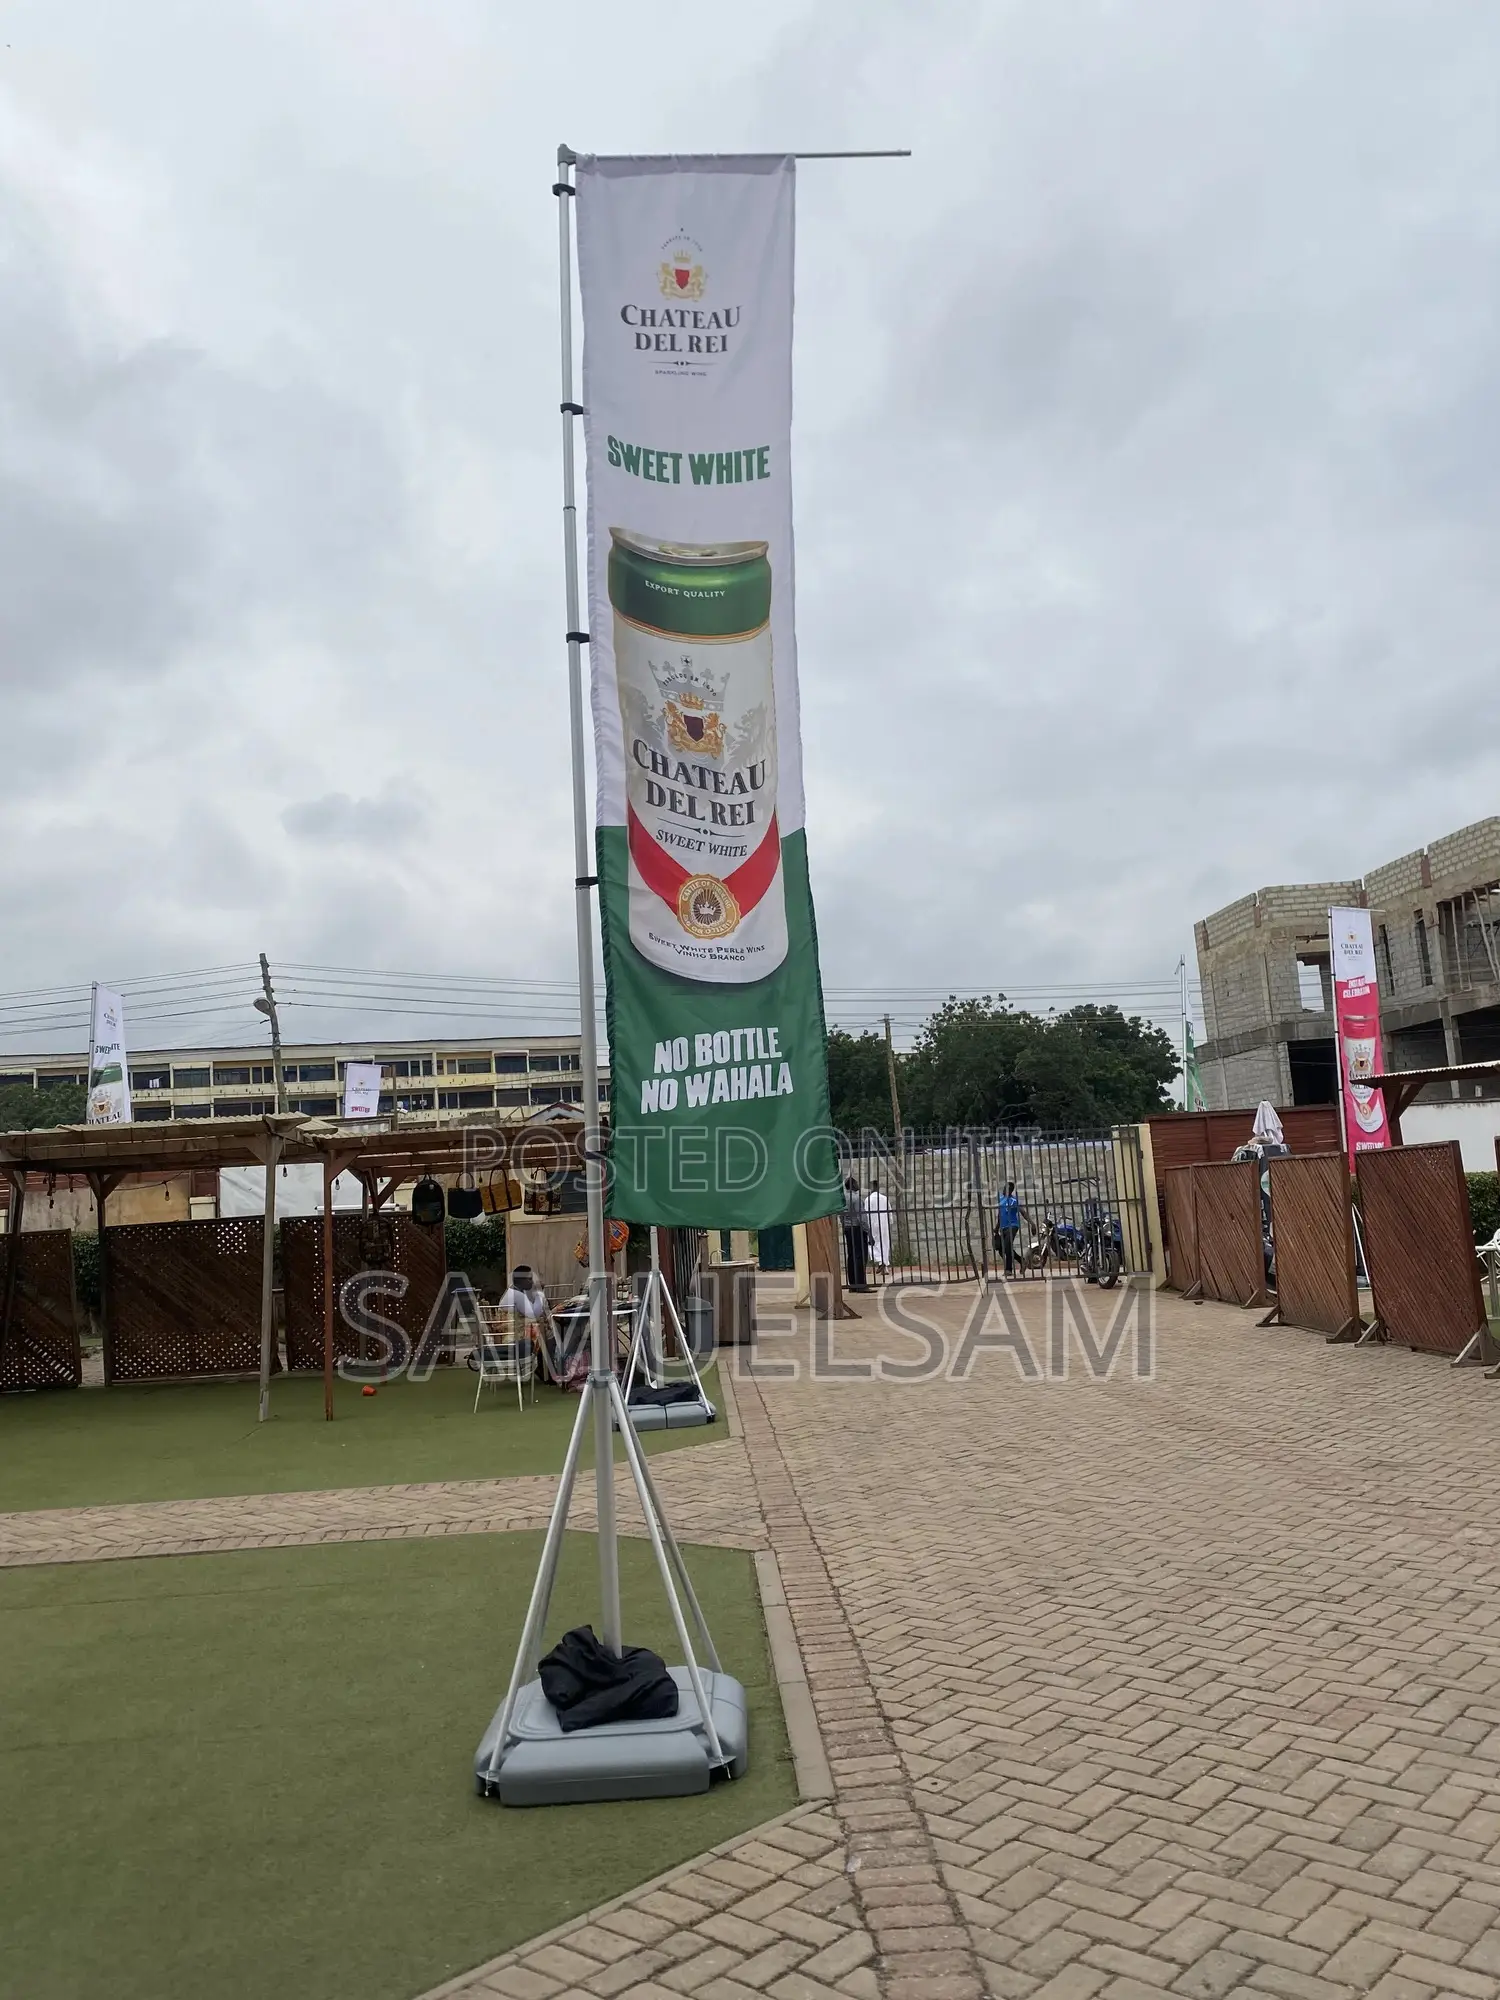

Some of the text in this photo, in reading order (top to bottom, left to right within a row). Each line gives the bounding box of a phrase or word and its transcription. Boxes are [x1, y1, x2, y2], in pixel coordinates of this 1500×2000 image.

[620, 304, 741, 330] CHATEAU
[635, 332, 728, 353] DEL REI
[607, 434, 771, 485] SWEET WHITE
[644, 580, 726, 598] EXPORT QUALITY
[633, 739, 766, 795] CHATEAU
[645, 778, 756, 827] DEL REI
[656, 829, 748, 857] SWEET WHITE
[648, 932, 676, 949] SWEET
[680, 944, 713, 953] WHITE
[675, 948, 745, 961] VINHO BRANCO
[653, 1027, 782, 1074] NO BOTTLE
[640, 1062, 794, 1114] NO WAHALA
